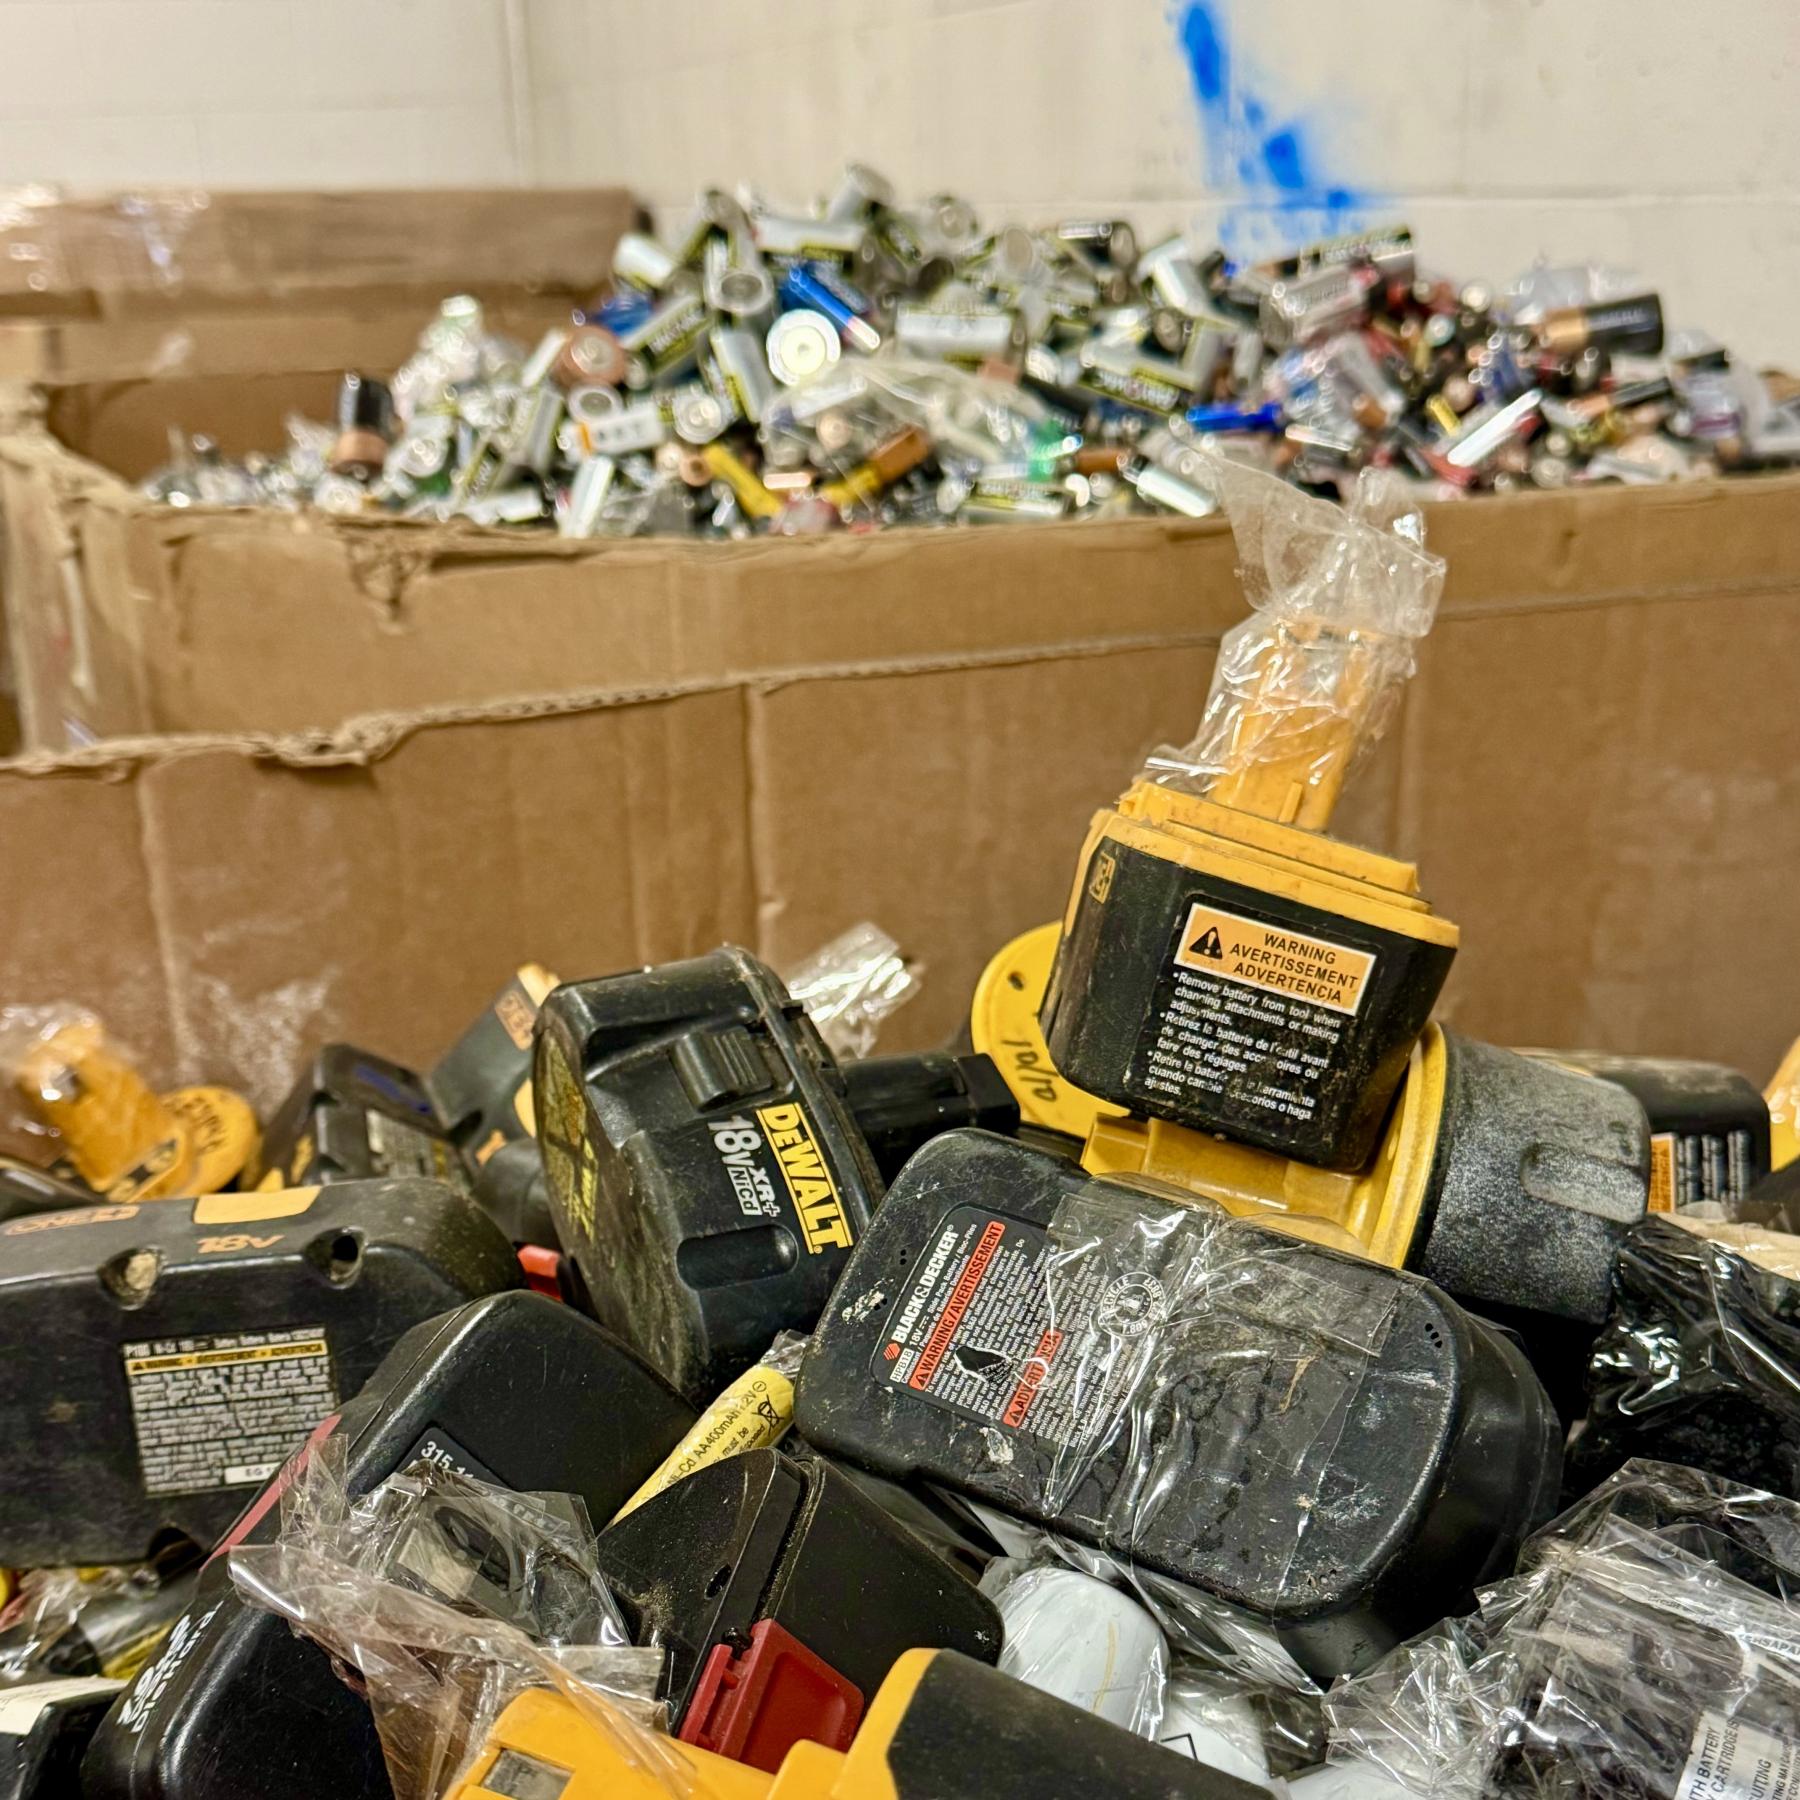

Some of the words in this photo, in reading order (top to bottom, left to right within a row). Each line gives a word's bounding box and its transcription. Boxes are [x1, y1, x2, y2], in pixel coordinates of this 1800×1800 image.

[1229, 943, 1358, 988] AVERTISSEMENT
[1264, 933, 1336, 964] WARNING
[1178, 972, 1220, 993] Remove
[1221, 985, 1258, 1005] battery
[1261, 996, 1286, 1012] from
[1289, 1005, 1310, 1019] tool
[1313, 1014, 1341, 1028] when
[1233, 962, 1340, 1003] ADVERTENCIA
[1165, 1011, 1201, 1031] Retirez
[1216, 1026, 1254, 1046] batterie
[1255, 1039, 1269, 1051] de
[1300, 1053, 1329, 1068] avant
[1224, 999, 1285, 1026] attachments
[1288, 1020, 1301, 1030] or
[1302, 1024, 1339, 1044] making
[1150, 1051, 1182, 1068] Retire
[1157, 1036, 1180, 1052] faire
[1182, 1045, 1201, 1059] des
[1161, 1025, 1174, 1036] de
[1178, 1031, 1219, 1050] changer
[1220, 1043, 1240, 1056] des
[1242, 1050, 1302, 1074] accoires
[1304, 1066, 1319, 1079] ou
[1148, 1065, 1186, 1082] cuando
[1286, 1105, 1312, 1120] haga
[707, 1116, 761, 1166] 18V
[749, 1165, 780, 1218] XR+
[731, 1171, 758, 1209] NiCd
[1015, 1239, 1025, 1248] Do
[890, 1347, 914, 1381] HPB18
[909, 1328, 923, 1346] 18V
[925, 1385, 934, 1393] To
[930, 1363, 945, 1384] reduce
[942, 1350, 952, 1363] risk
[948, 1342, 955, 1350] of
[1013, 1330, 1061, 1409] ADVERTNCIA
[693, 1410, 741, 1459] AA400mAh
[722, 1437, 739, 1456] must
[737, 1427, 749, 1439] be
[1697, 1727, 1721, 1779] BATTERY
[1711, 1729, 1738, 1793] CARTRIDGE
[1748, 1758, 1772, 1800] UITING
